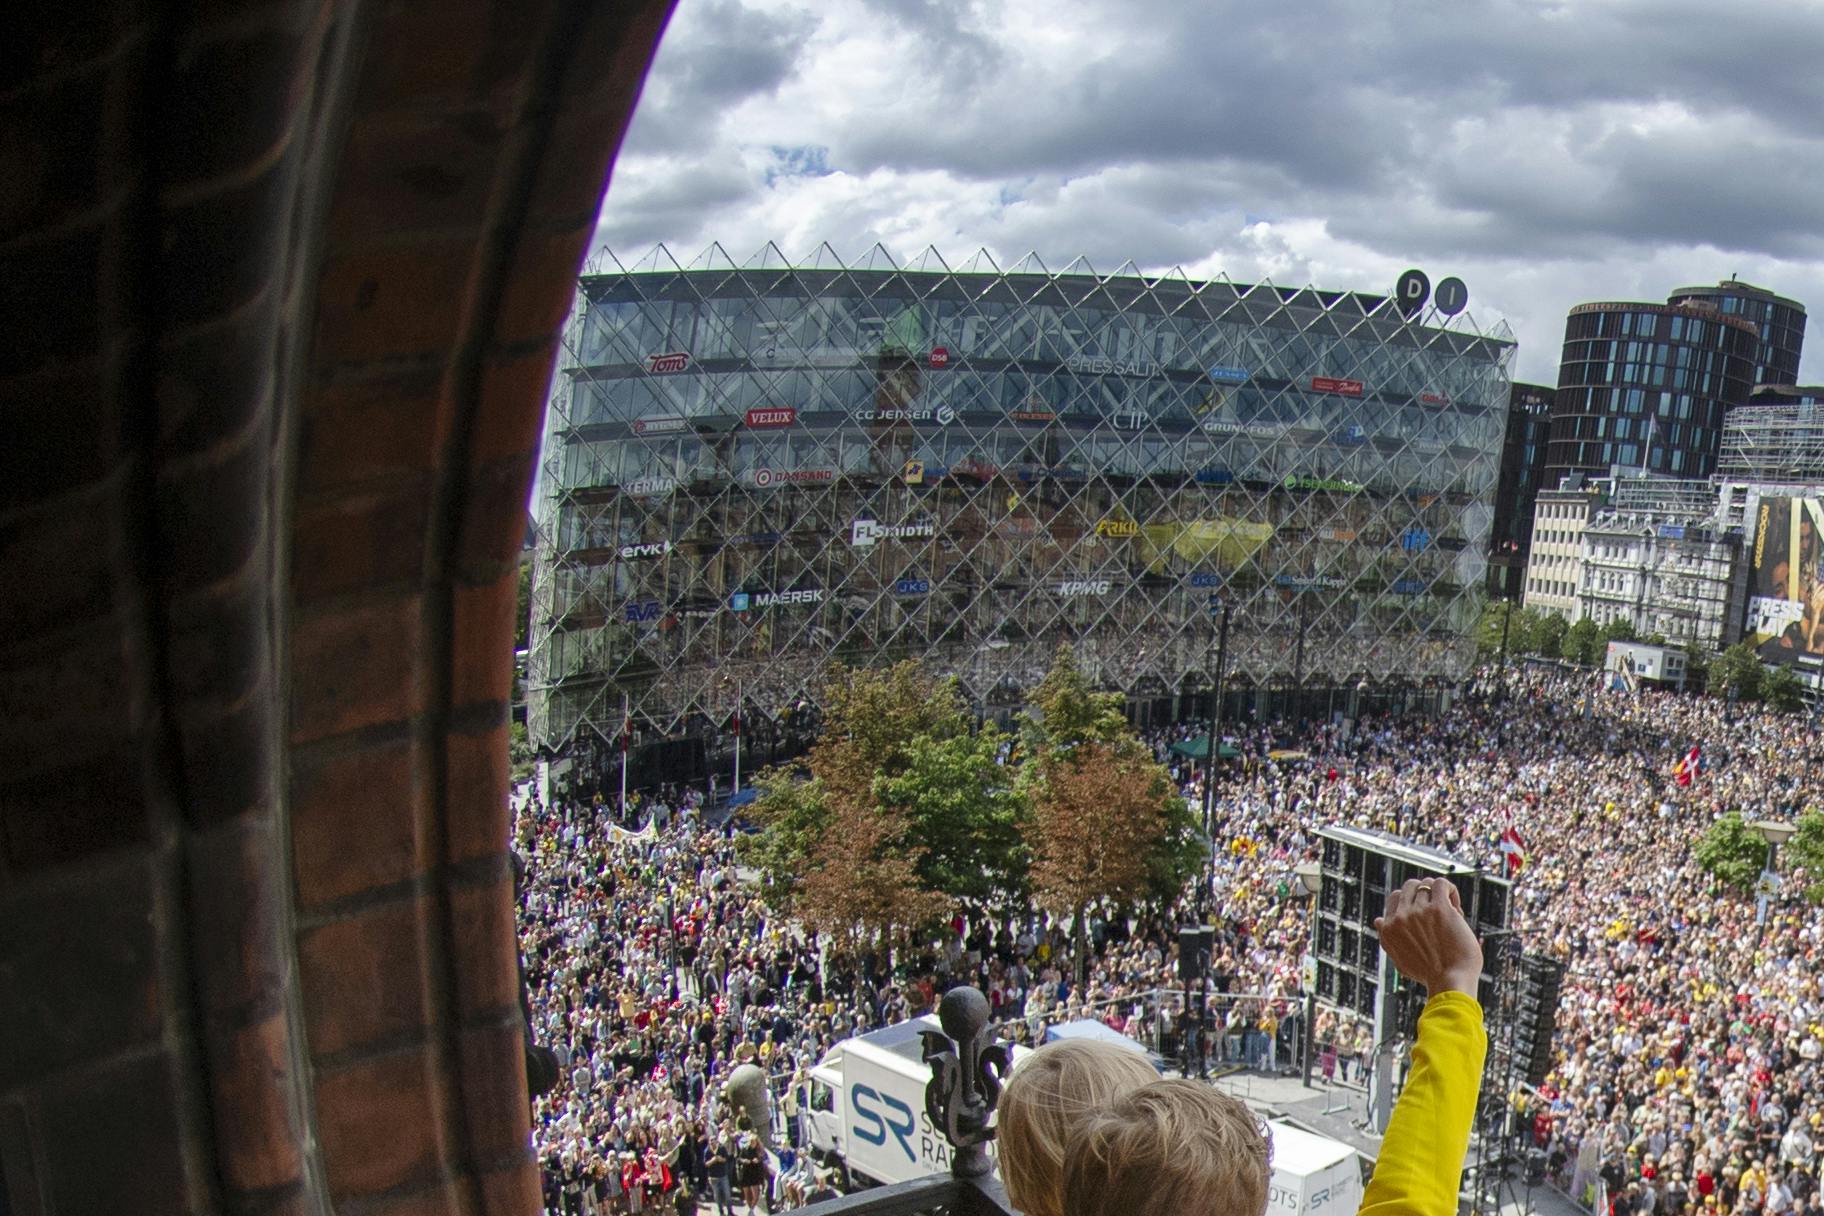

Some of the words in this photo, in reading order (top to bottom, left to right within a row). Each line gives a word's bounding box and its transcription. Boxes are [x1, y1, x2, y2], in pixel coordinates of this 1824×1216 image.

[1406, 278, 1422, 298] D
[650, 353, 689, 372] Toms
[931, 353, 947, 362] DSB
[751, 410, 793, 426] VELUX
[855, 410, 874, 420] CG
[774, 470, 832, 483] DANSAND
[622, 544, 661, 558] eryk
[1058, 580, 1110, 597] KPMG
[755, 589, 824, 607] MAERSK
[1748, 596, 1805, 622] PRESS
[1745, 613, 1793, 638] PLAY
[851, 1082, 917, 1163] SR
